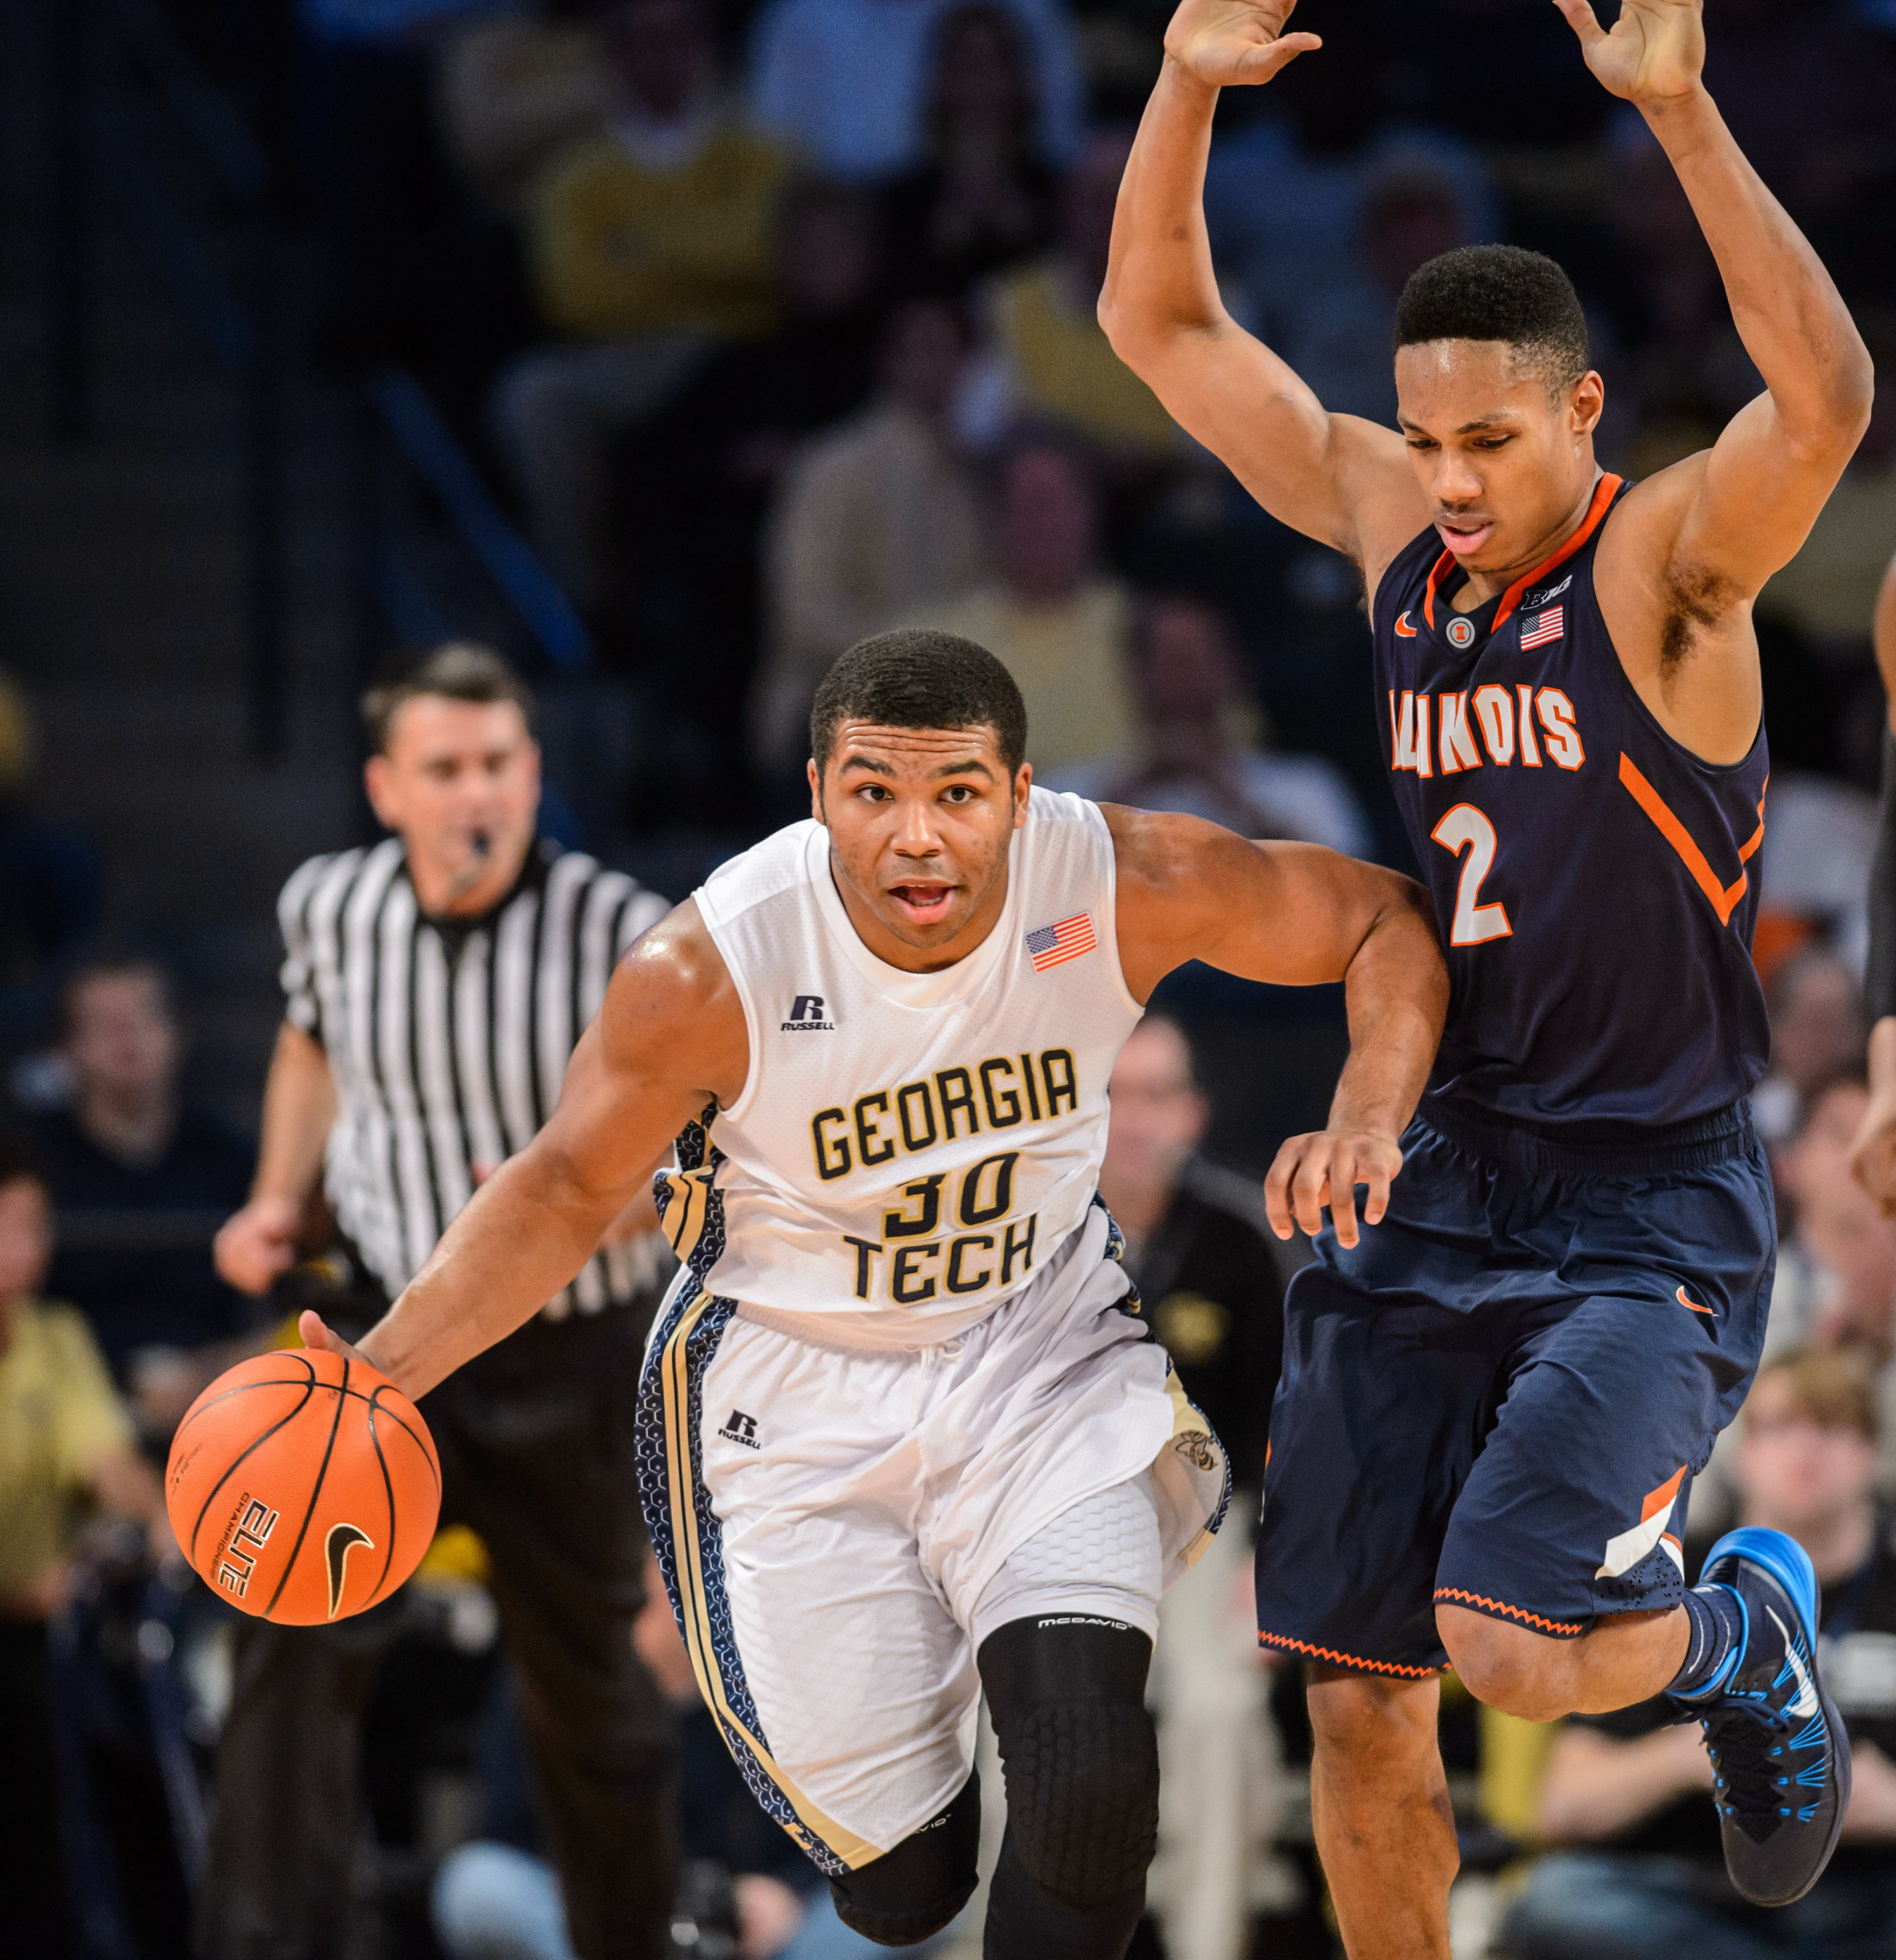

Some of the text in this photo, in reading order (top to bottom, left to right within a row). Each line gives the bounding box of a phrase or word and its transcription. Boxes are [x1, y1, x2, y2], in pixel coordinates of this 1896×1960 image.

[1430, 802, 1513, 946] 2
[780, 1022, 835, 1032] RUSSELL
[790, 995, 824, 1021] R
[810, 1047, 1079, 1182] GEORGIA
[881, 1151, 1021, 1242] 30
[841, 1211, 1039, 1305] TECH
[725, 1408, 757, 1439] R
[217, 1497, 280, 1599] ELITE
